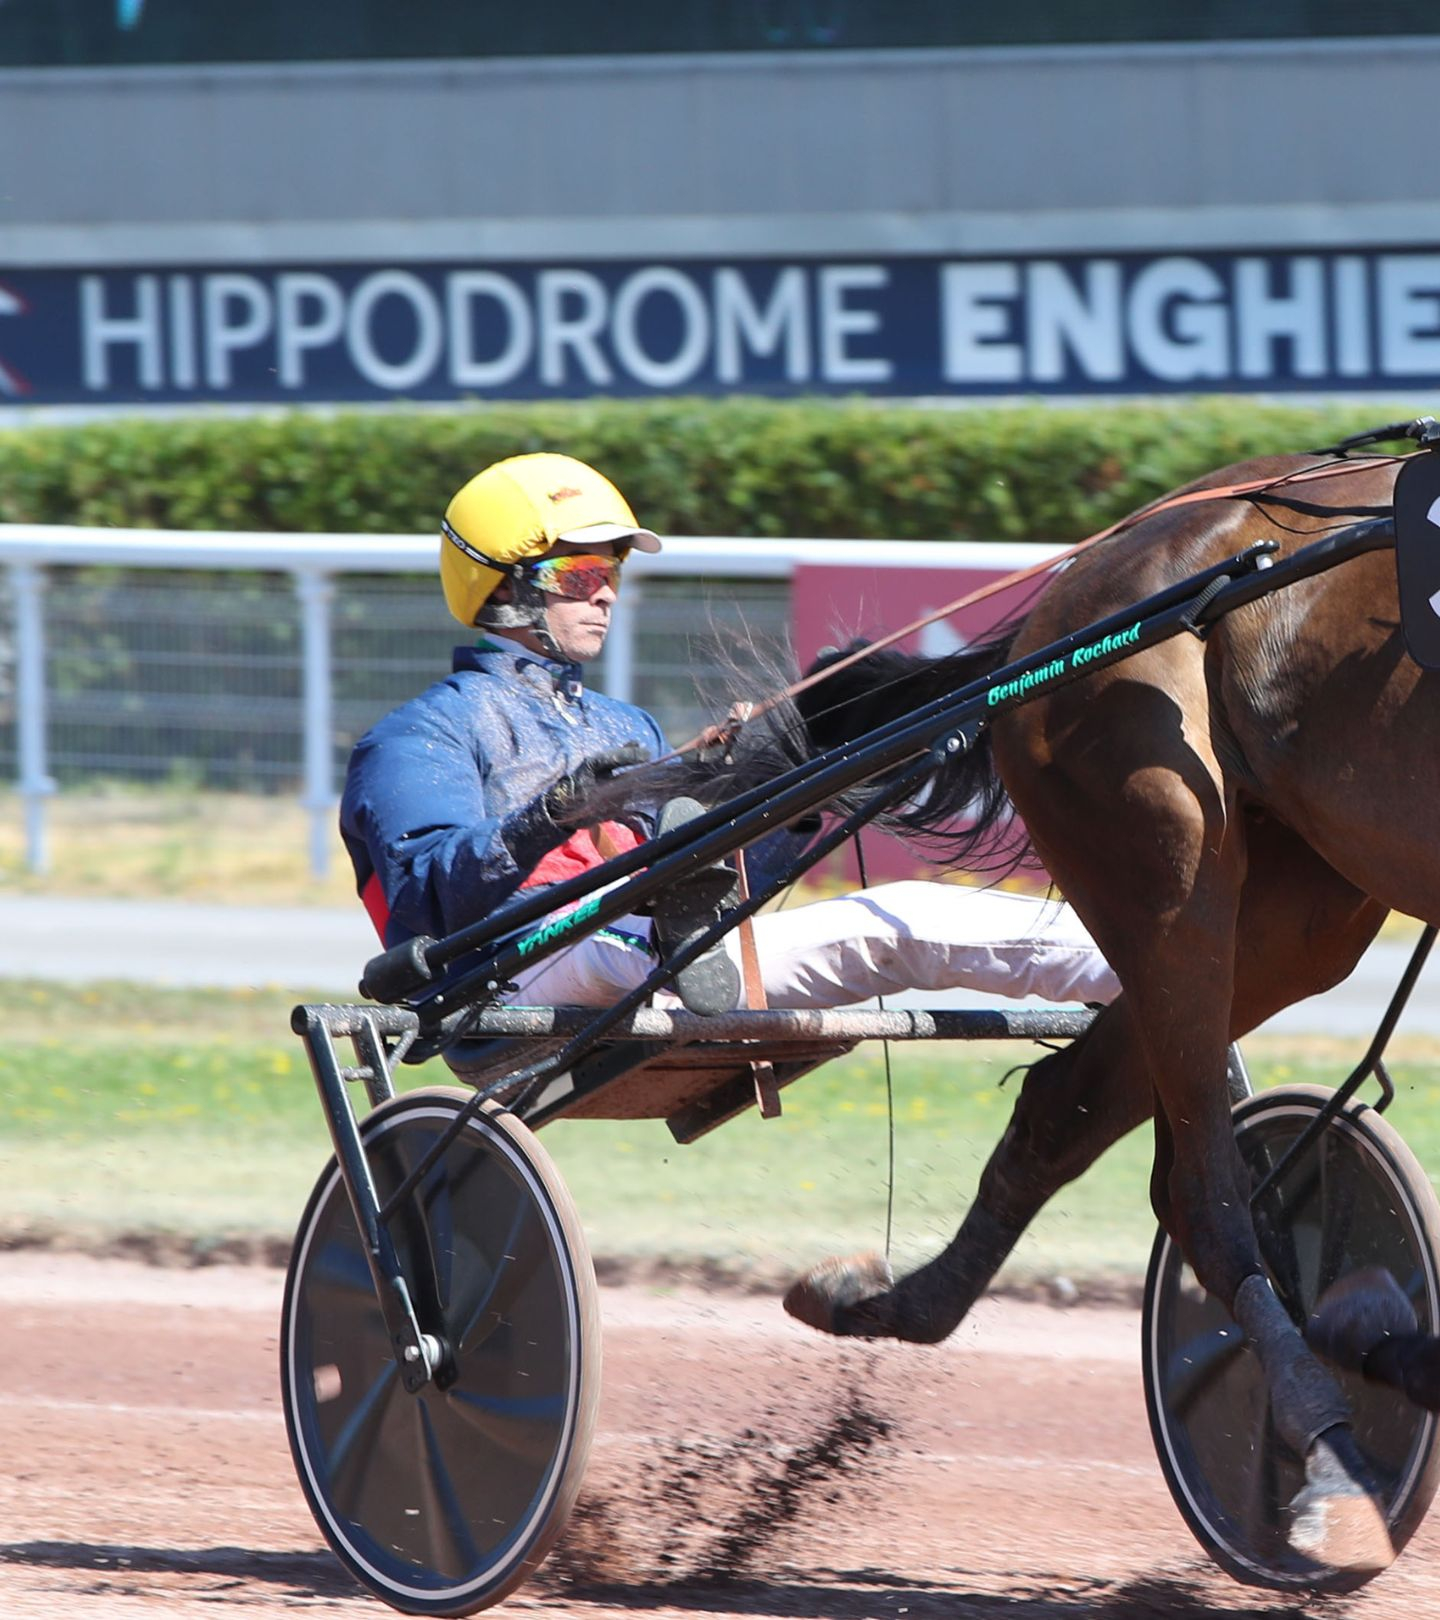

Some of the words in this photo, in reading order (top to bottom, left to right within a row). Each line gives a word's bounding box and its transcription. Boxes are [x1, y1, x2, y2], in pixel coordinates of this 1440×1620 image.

[79, 266, 895, 390] HIPPODROME
[986, 659, 1066, 707] Benjamin
[1071, 620, 1143, 668] Rochard
[516, 896, 602, 956] YANKEE
